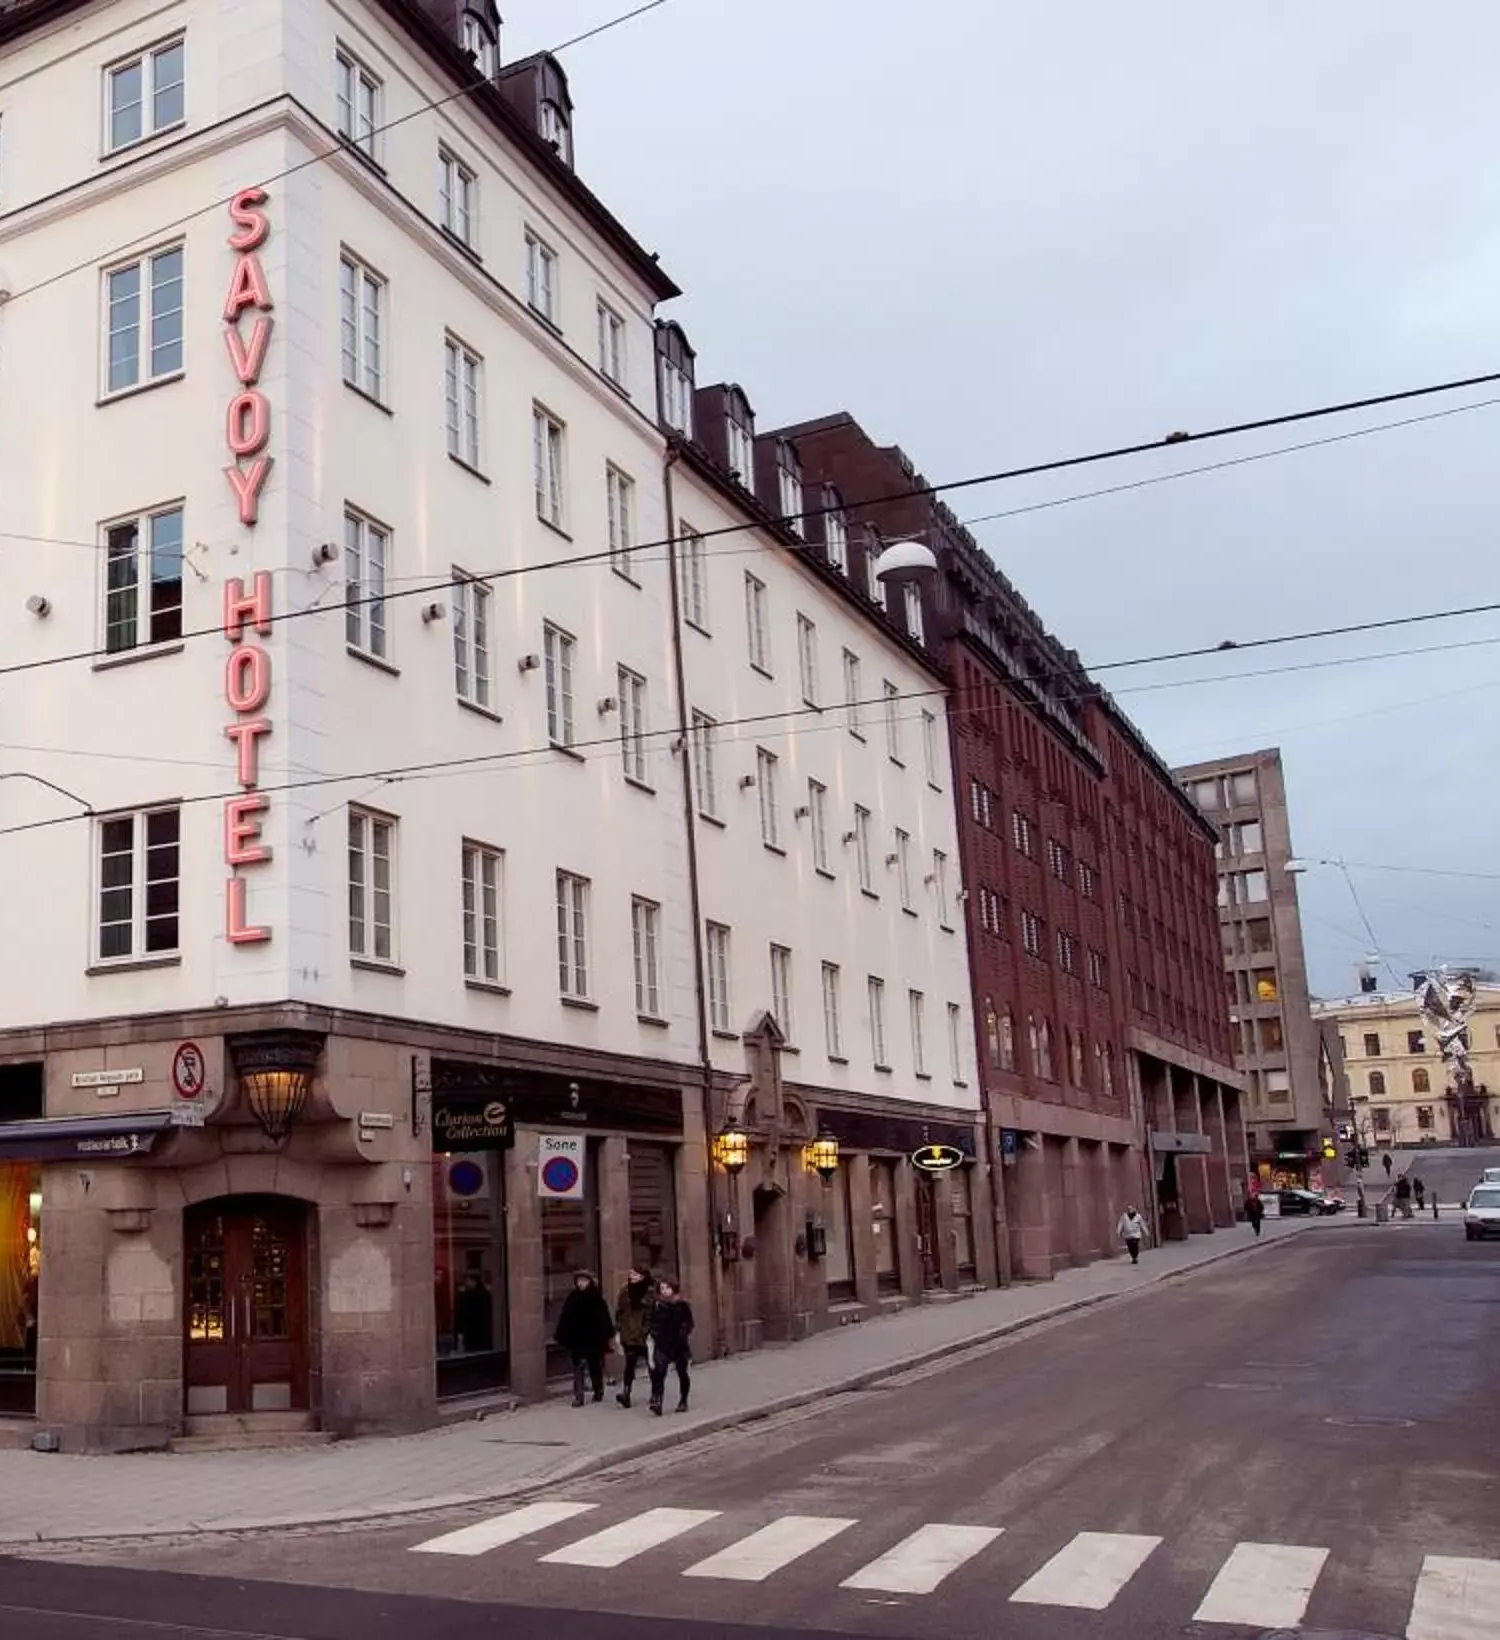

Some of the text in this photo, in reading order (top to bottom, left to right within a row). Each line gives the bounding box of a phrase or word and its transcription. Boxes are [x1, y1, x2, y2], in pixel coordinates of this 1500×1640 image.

[223, 186, 274, 943] SAVOY HOTEL
[545, 1137, 578, 1151] Sone
